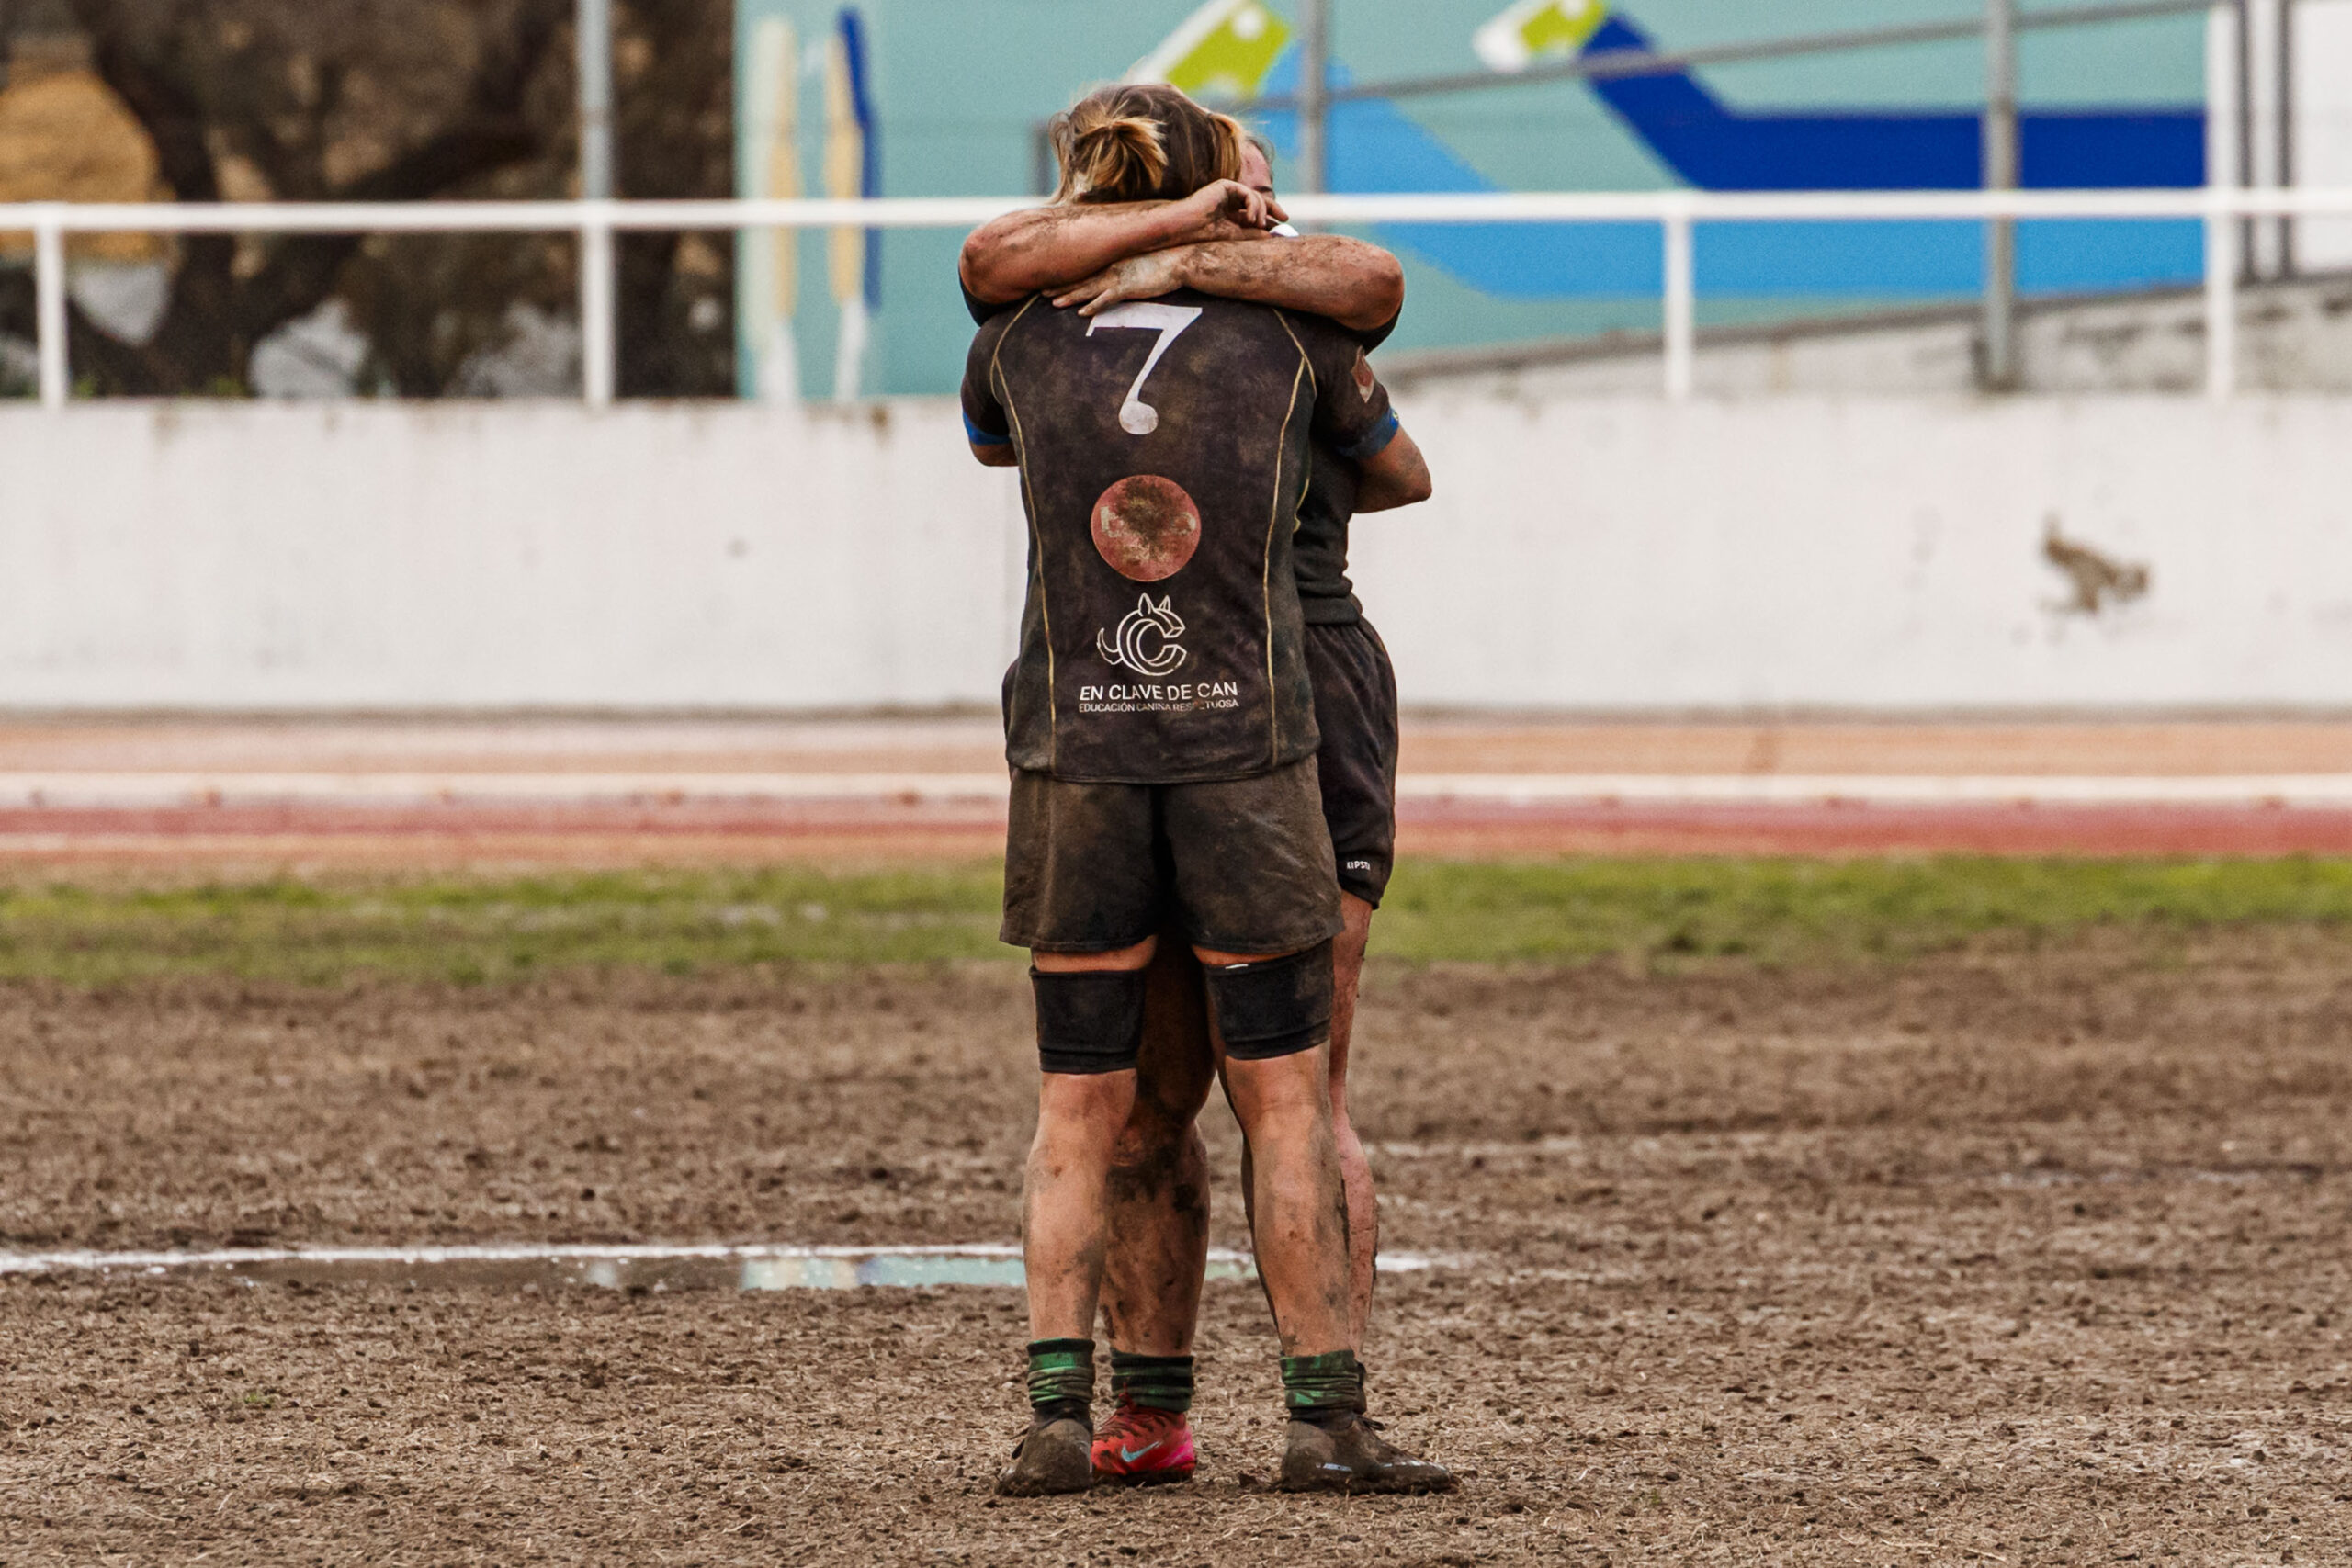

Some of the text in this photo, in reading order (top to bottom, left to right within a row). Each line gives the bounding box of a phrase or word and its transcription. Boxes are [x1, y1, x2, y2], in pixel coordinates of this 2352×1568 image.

[1085, 303, 1203, 435] 7
[1080, 681, 1238, 701] EN CLAVE DE CAN
[1079, 702, 1136, 713] EDUCACIÓN
